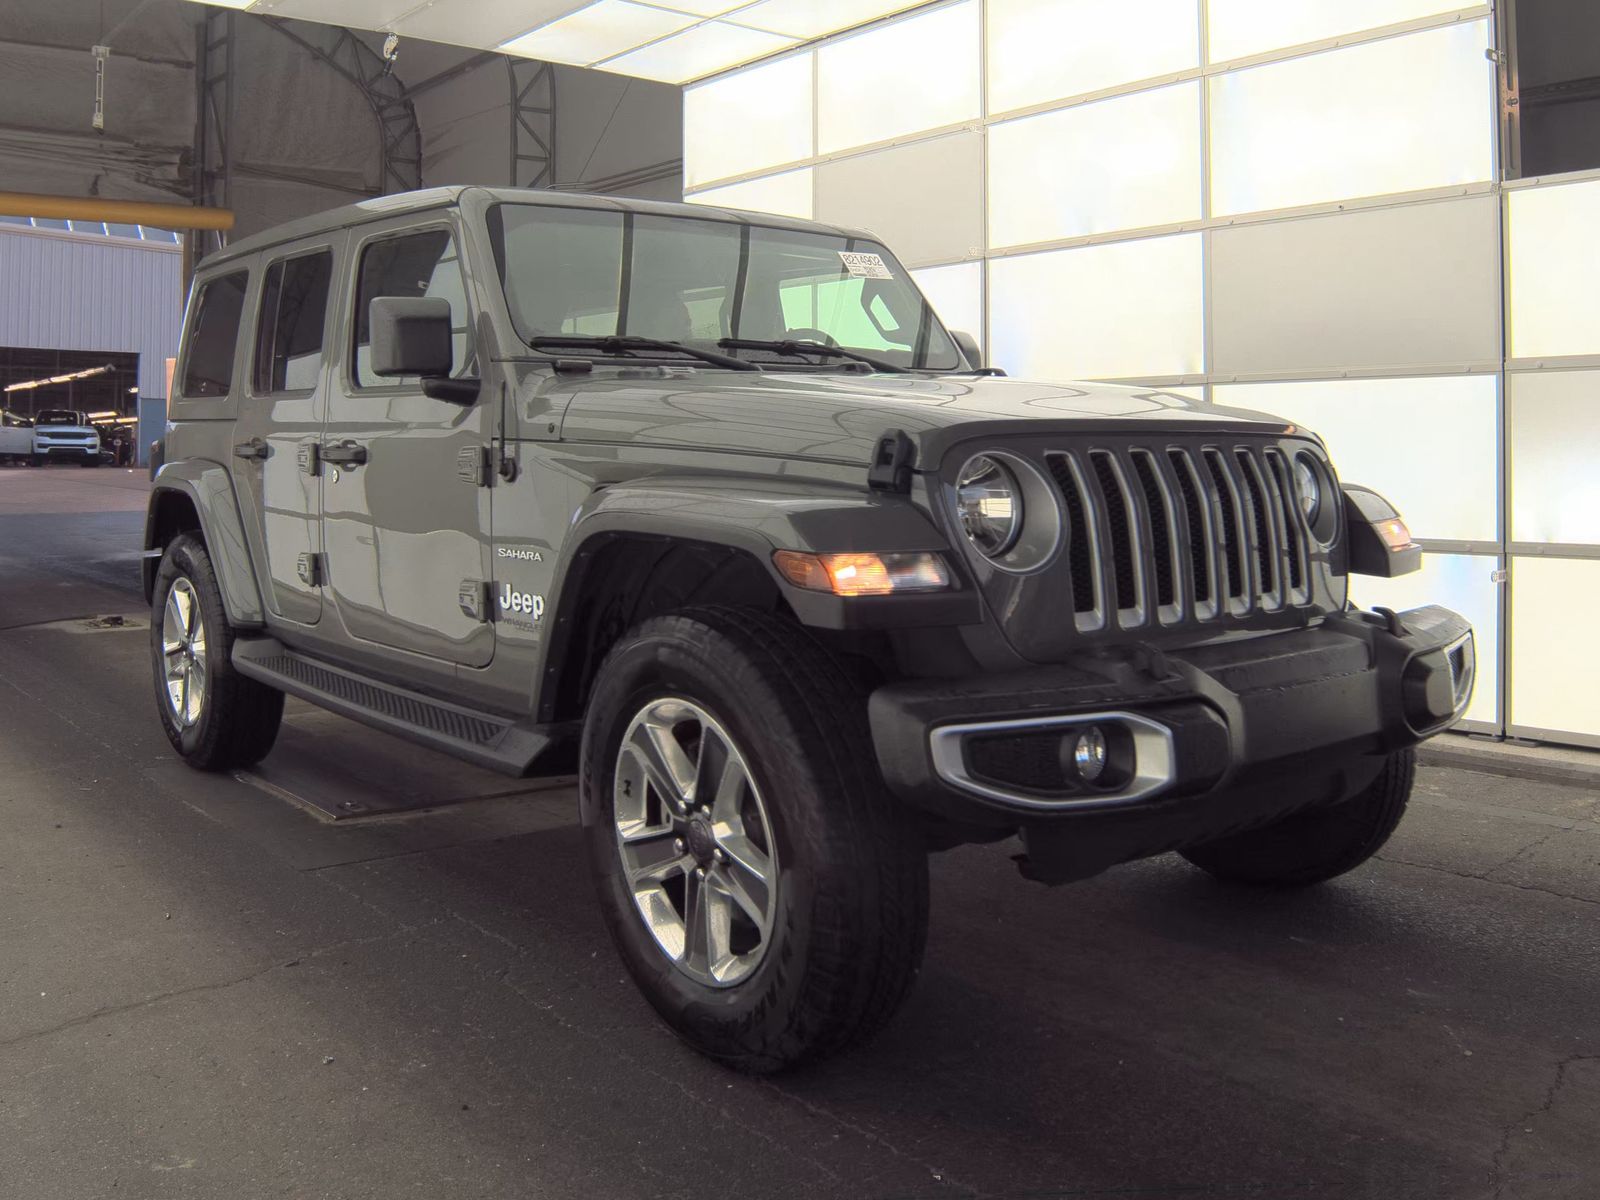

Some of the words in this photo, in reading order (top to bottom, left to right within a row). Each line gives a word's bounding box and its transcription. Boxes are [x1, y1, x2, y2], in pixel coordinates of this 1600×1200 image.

[842, 254, 883, 266] 8214902
[498, 548, 543, 562] SAHARA
[499, 583, 545, 620] Jeep
